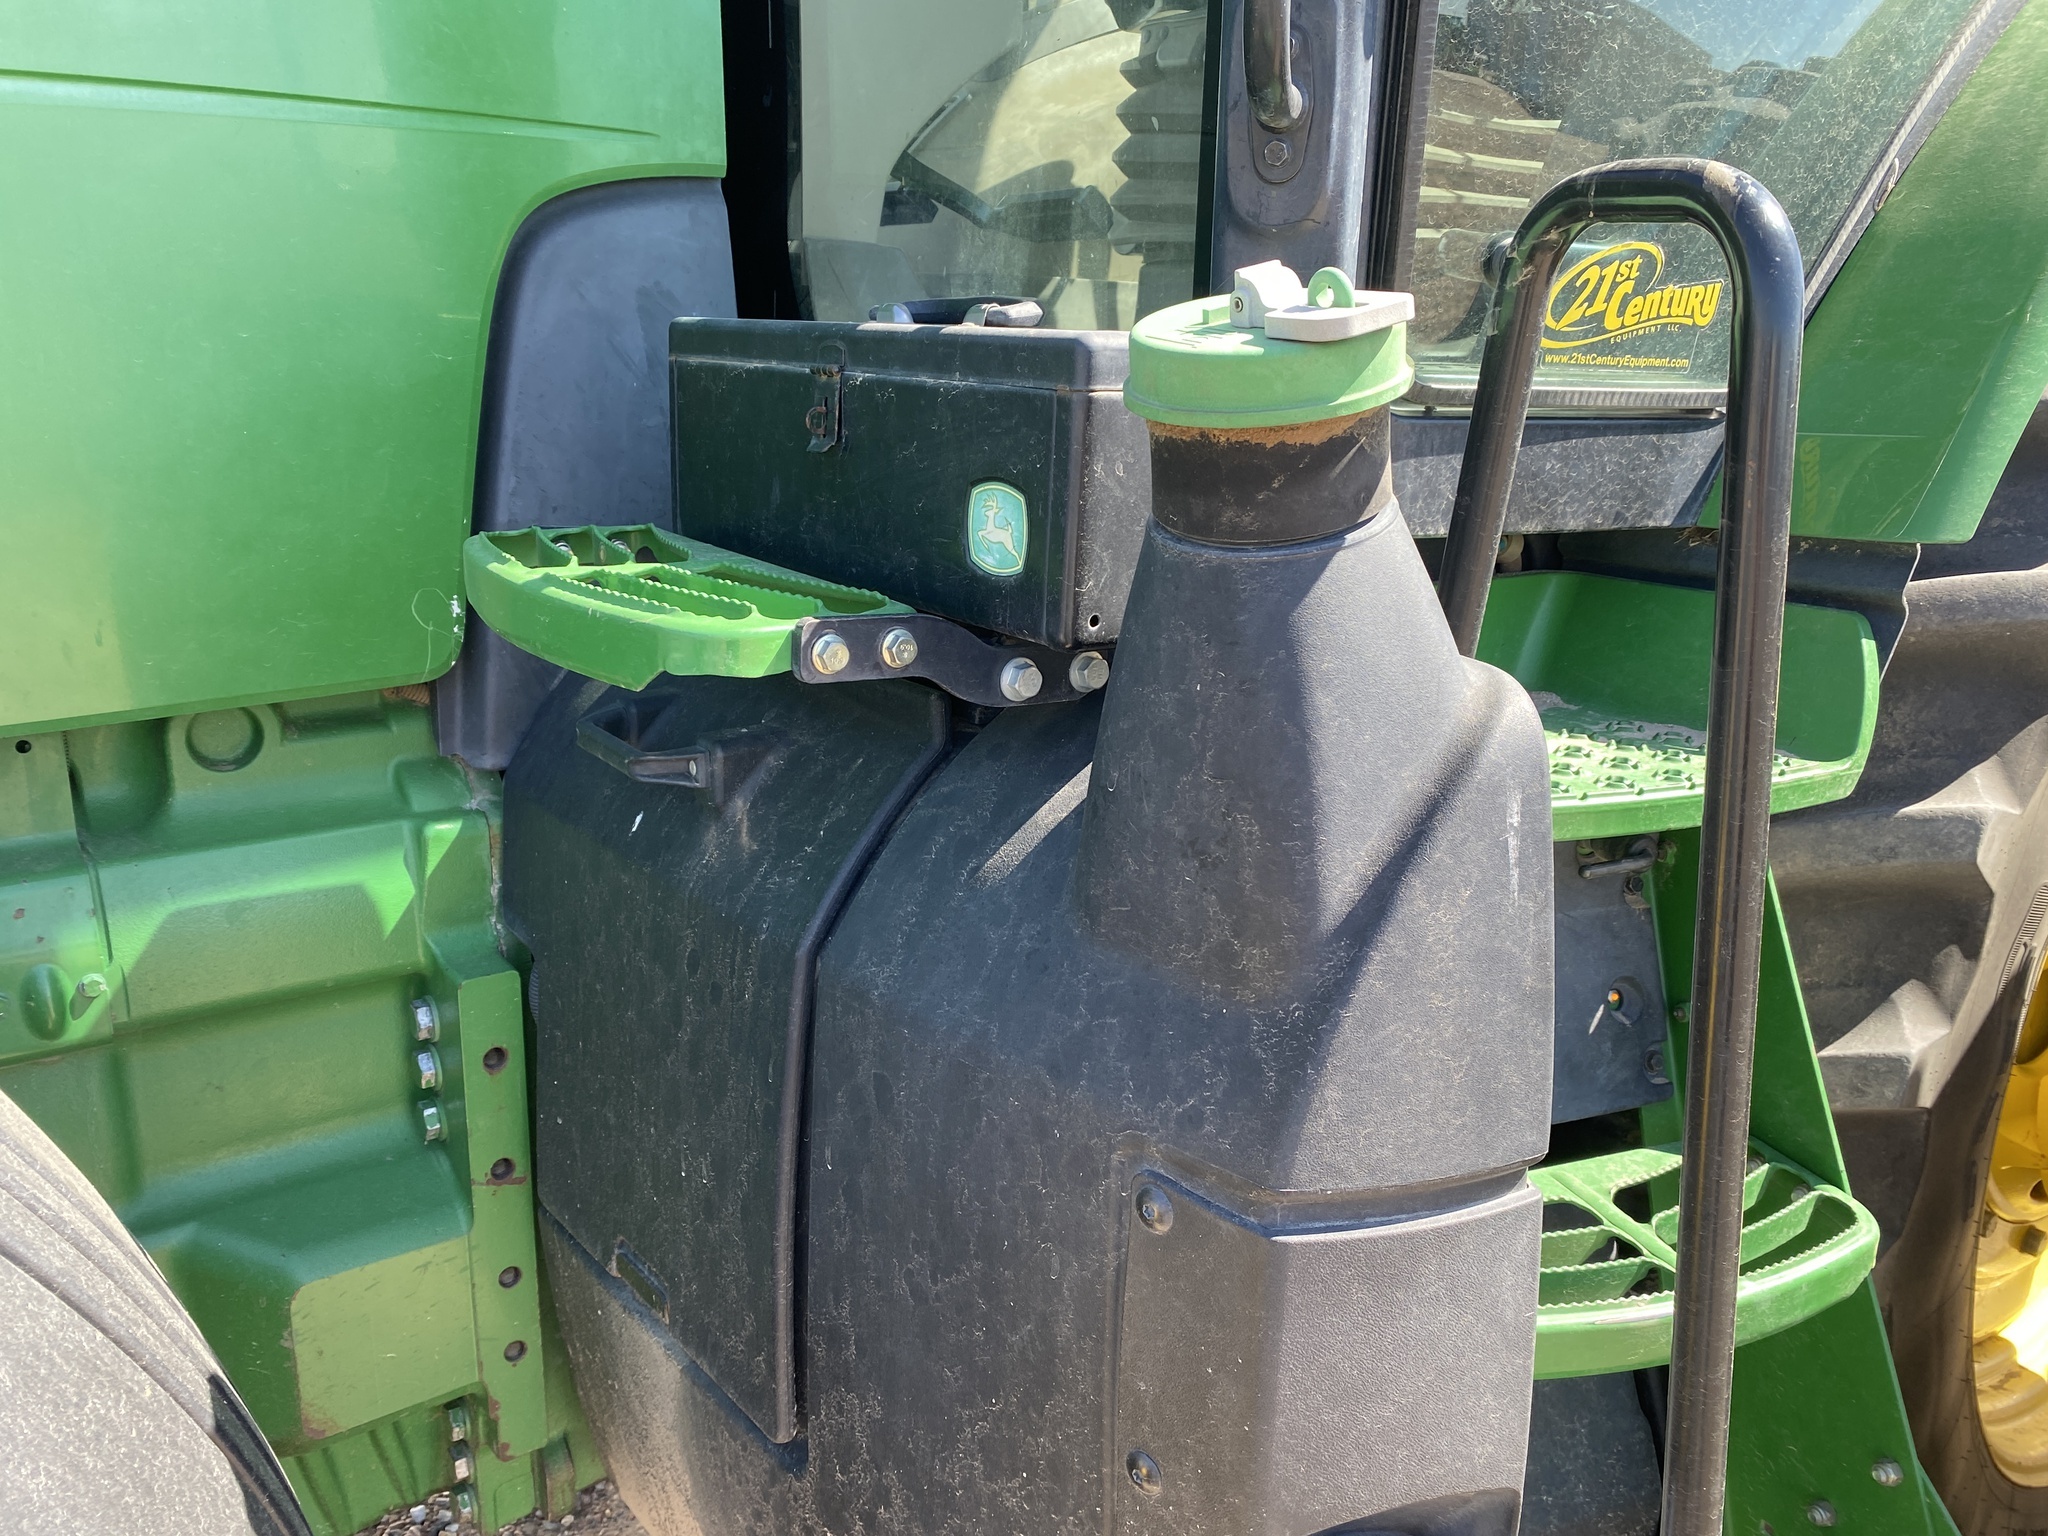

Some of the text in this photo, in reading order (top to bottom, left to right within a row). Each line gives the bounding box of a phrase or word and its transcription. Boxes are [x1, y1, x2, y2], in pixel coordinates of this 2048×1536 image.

[1556, 254, 1643, 330] 21st
[1604, 280, 1723, 331] Century
[1610, 324, 1661, 344] EQUIPMENT
[1544, 352, 1689, 369] www.21stCenturyEquipment.com
